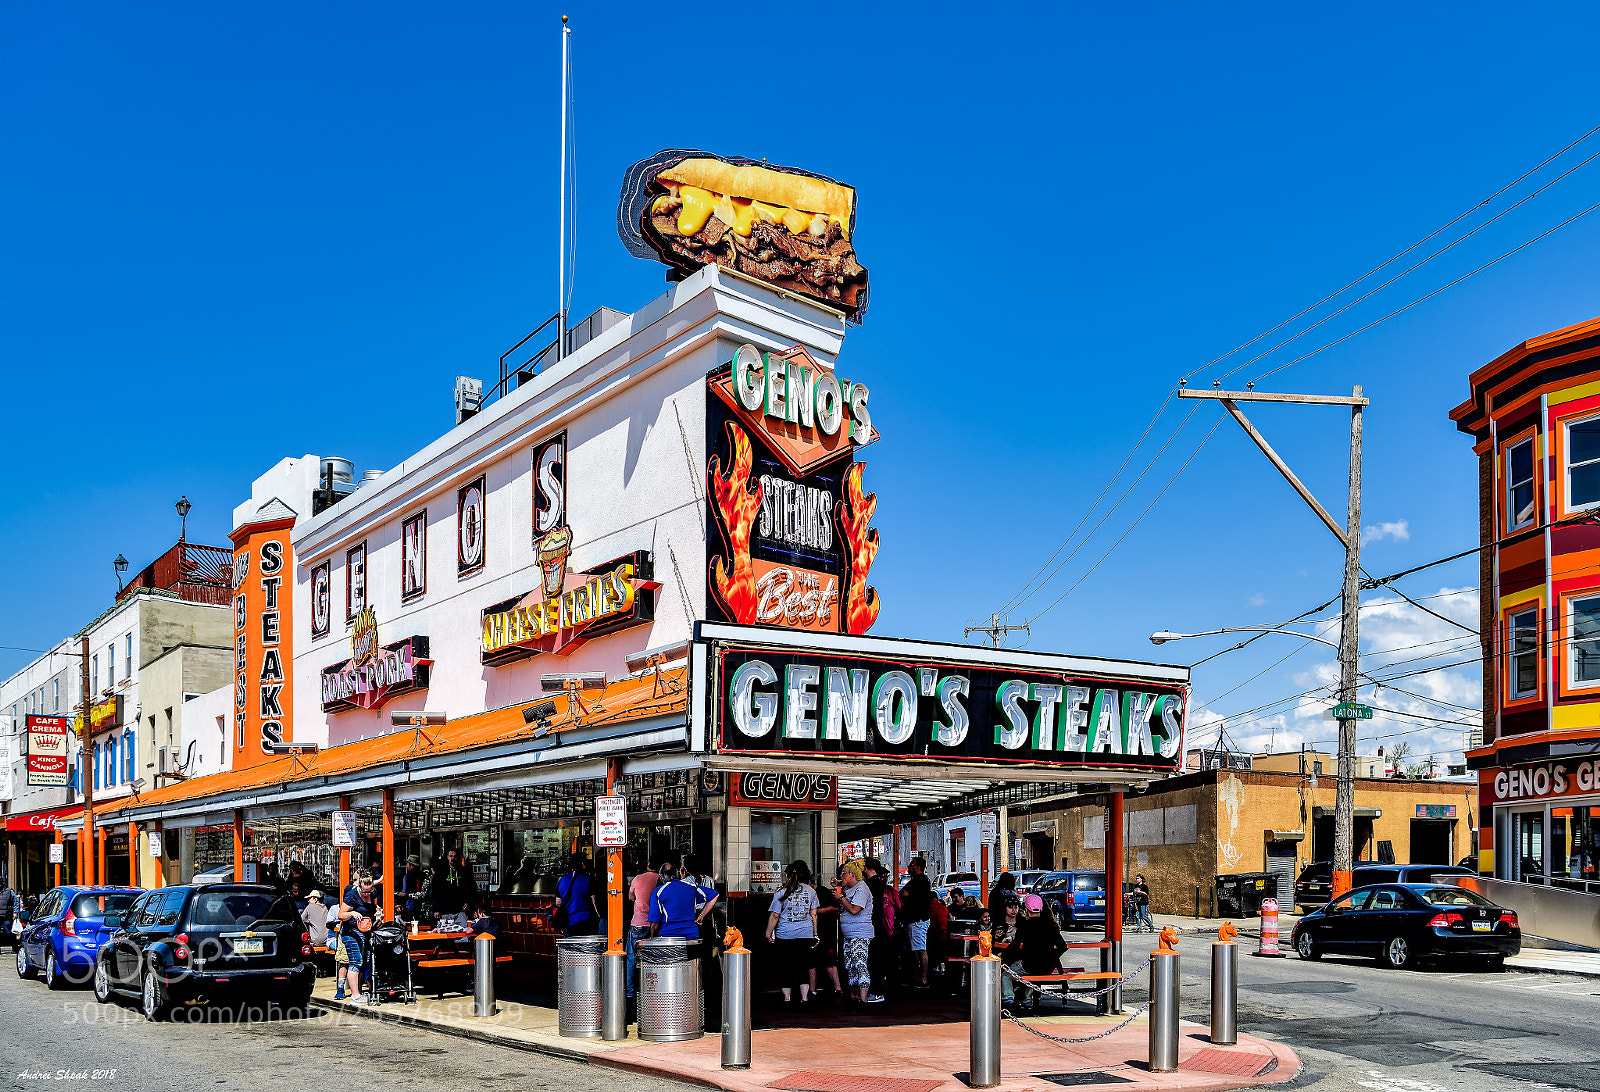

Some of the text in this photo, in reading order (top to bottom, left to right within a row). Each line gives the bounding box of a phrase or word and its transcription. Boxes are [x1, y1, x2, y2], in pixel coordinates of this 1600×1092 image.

[732, 344, 871, 445] GENO'S
[759, 474, 833, 550] STEAKS
[755, 566, 838, 622] Best
[795, 570, 820, 588] THE
[481, 600, 558, 652] CHEESE
[560, 564, 634, 629] FRIES
[260, 540, 284, 756] STEAKS
[321, 666, 361, 703] ROAST
[365, 644, 411, 691] PORK
[31, 725, 63, 733] CREMA
[729, 660, 1182, 759] GENO'S STEAKS
[1334, 708, 1363, 718] LATONA
[30, 760, 64, 771] CANNOLI
[743, 772, 831, 800] GENO'S
[1494, 763, 1568, 799] GENO'S
